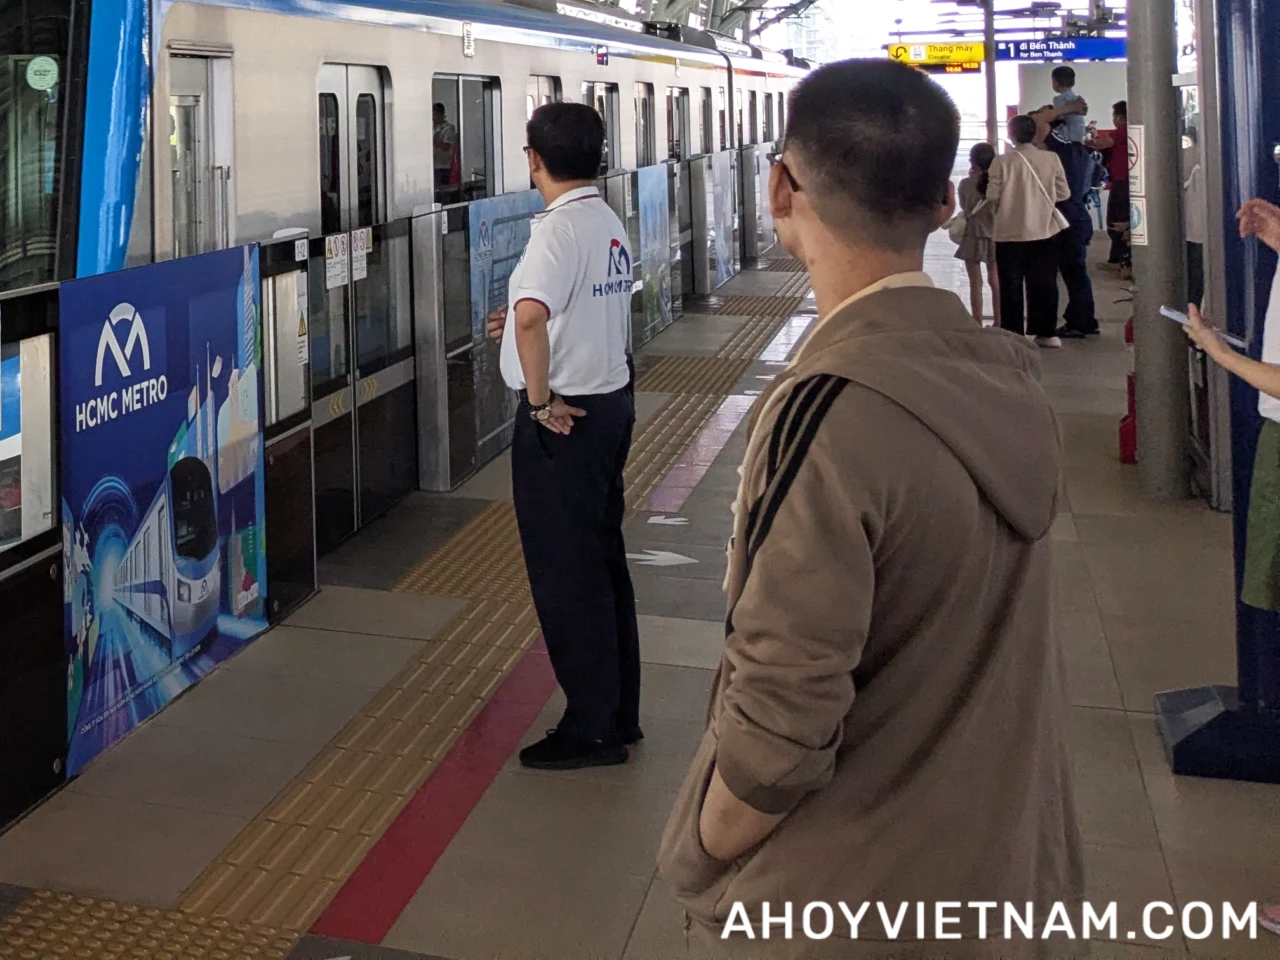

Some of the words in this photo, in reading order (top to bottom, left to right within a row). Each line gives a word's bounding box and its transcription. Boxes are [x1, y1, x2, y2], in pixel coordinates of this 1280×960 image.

[928, 45, 954, 53] Thang
[1008, 43, 1015, 58] 1
[1029, 40, 1047, 50] Bến
[1048, 41, 1076, 50] Thành
[75, 393, 118, 433] HCMC
[122, 374, 168, 415] METRO
